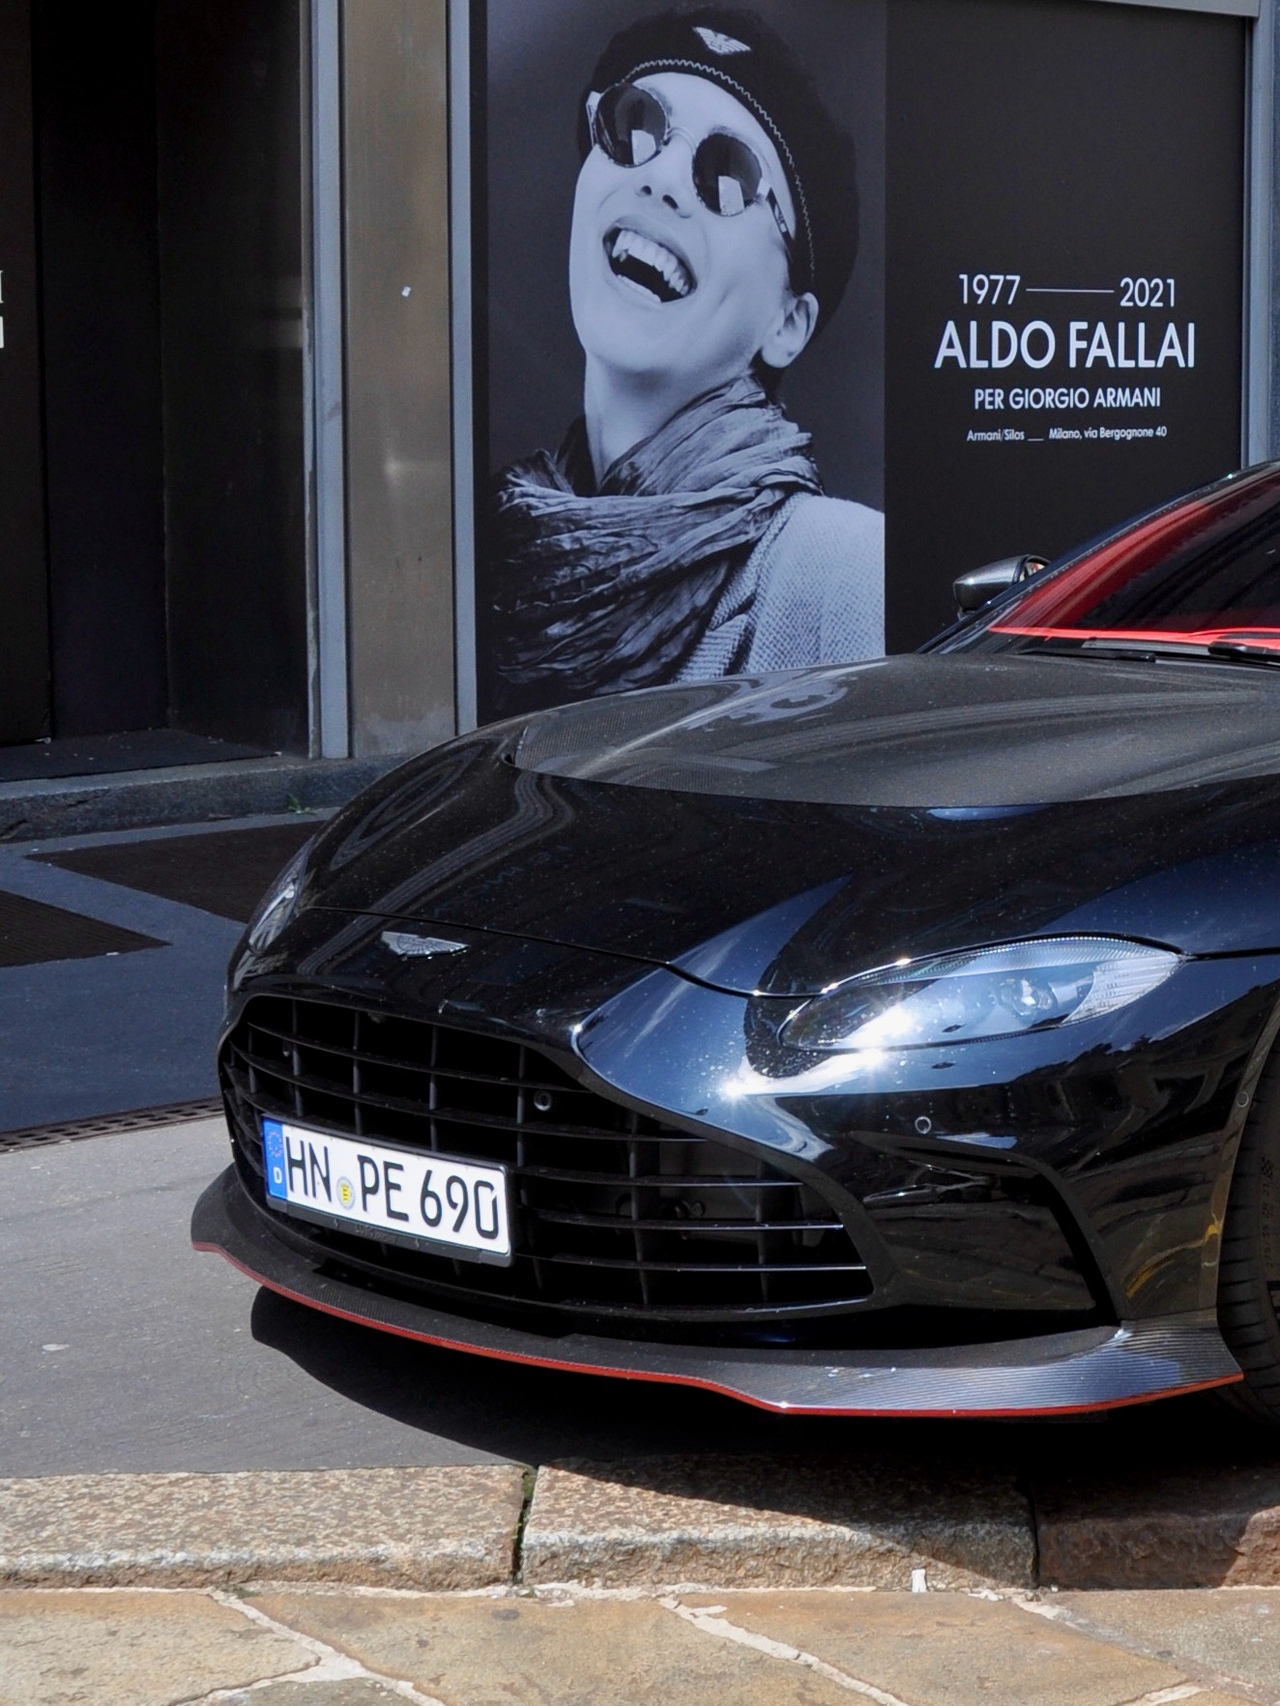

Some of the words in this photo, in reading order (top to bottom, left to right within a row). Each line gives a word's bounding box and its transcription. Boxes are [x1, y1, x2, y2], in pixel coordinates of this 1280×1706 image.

[959, 274, 1021, 305] 1977
[1119, 277, 1175, 307] 2021
[934, 320, 1056, 369] ALDO
[1069, 321, 1195, 368] FALLAI
[974, 388, 1004, 409] PER
[1009, 387, 1089, 409] GIORGIO
[1093, 387, 1161, 408] ARMANI
[966, 428, 1025, 442] Armani/Silos
[1049, 427, 1082, 441] Milano,
[1084, 427, 1098, 439] via
[1099, 426, 1154, 441] Bergognone
[1155, 425, 1167, 437] 40
[273, 1167, 282, 1184] D
[285, 1136, 332, 1203] HN
[357, 1154, 409, 1222] PE
[420, 1170, 500, 1240] 690
